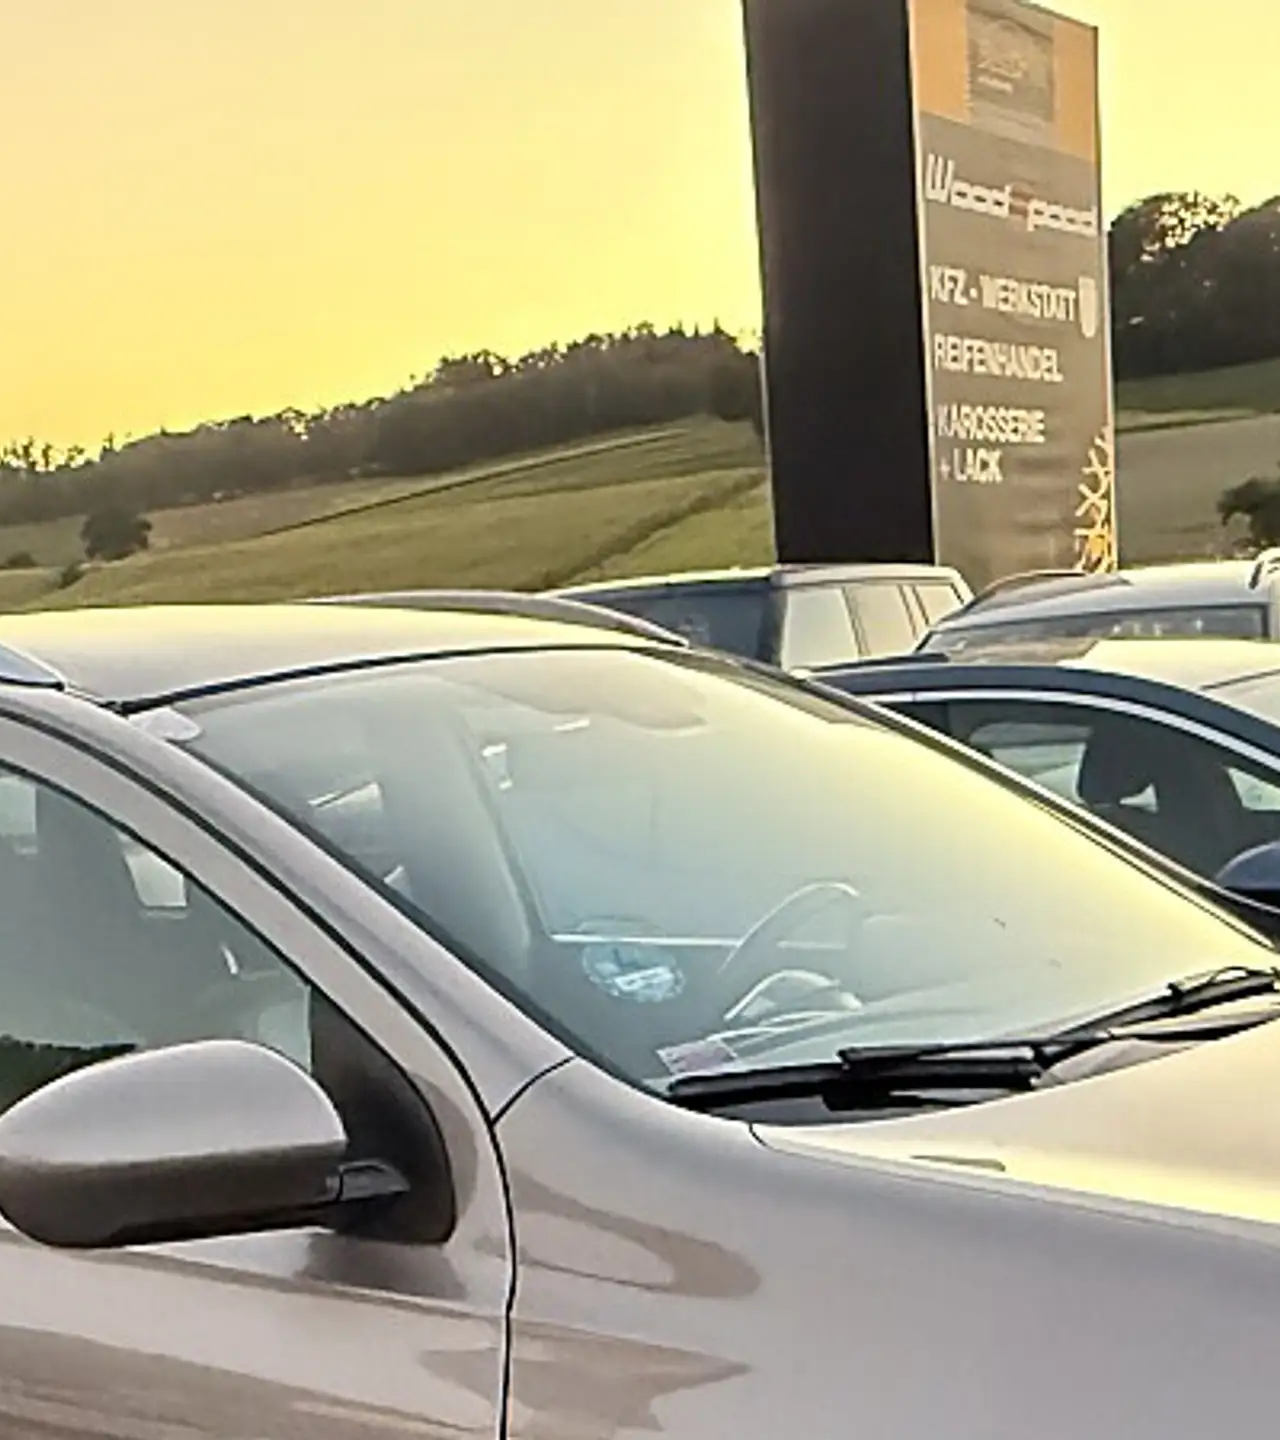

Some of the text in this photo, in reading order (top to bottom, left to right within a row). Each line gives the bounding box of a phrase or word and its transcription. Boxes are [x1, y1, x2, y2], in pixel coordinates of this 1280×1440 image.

[930, 265, 969, 306] KFZ
[934, 333, 1064, 382] REIFENHANDEL
[936, 404, 1046, 443] KAROSSERIE
[953, 447, 1003, 482] LACK
